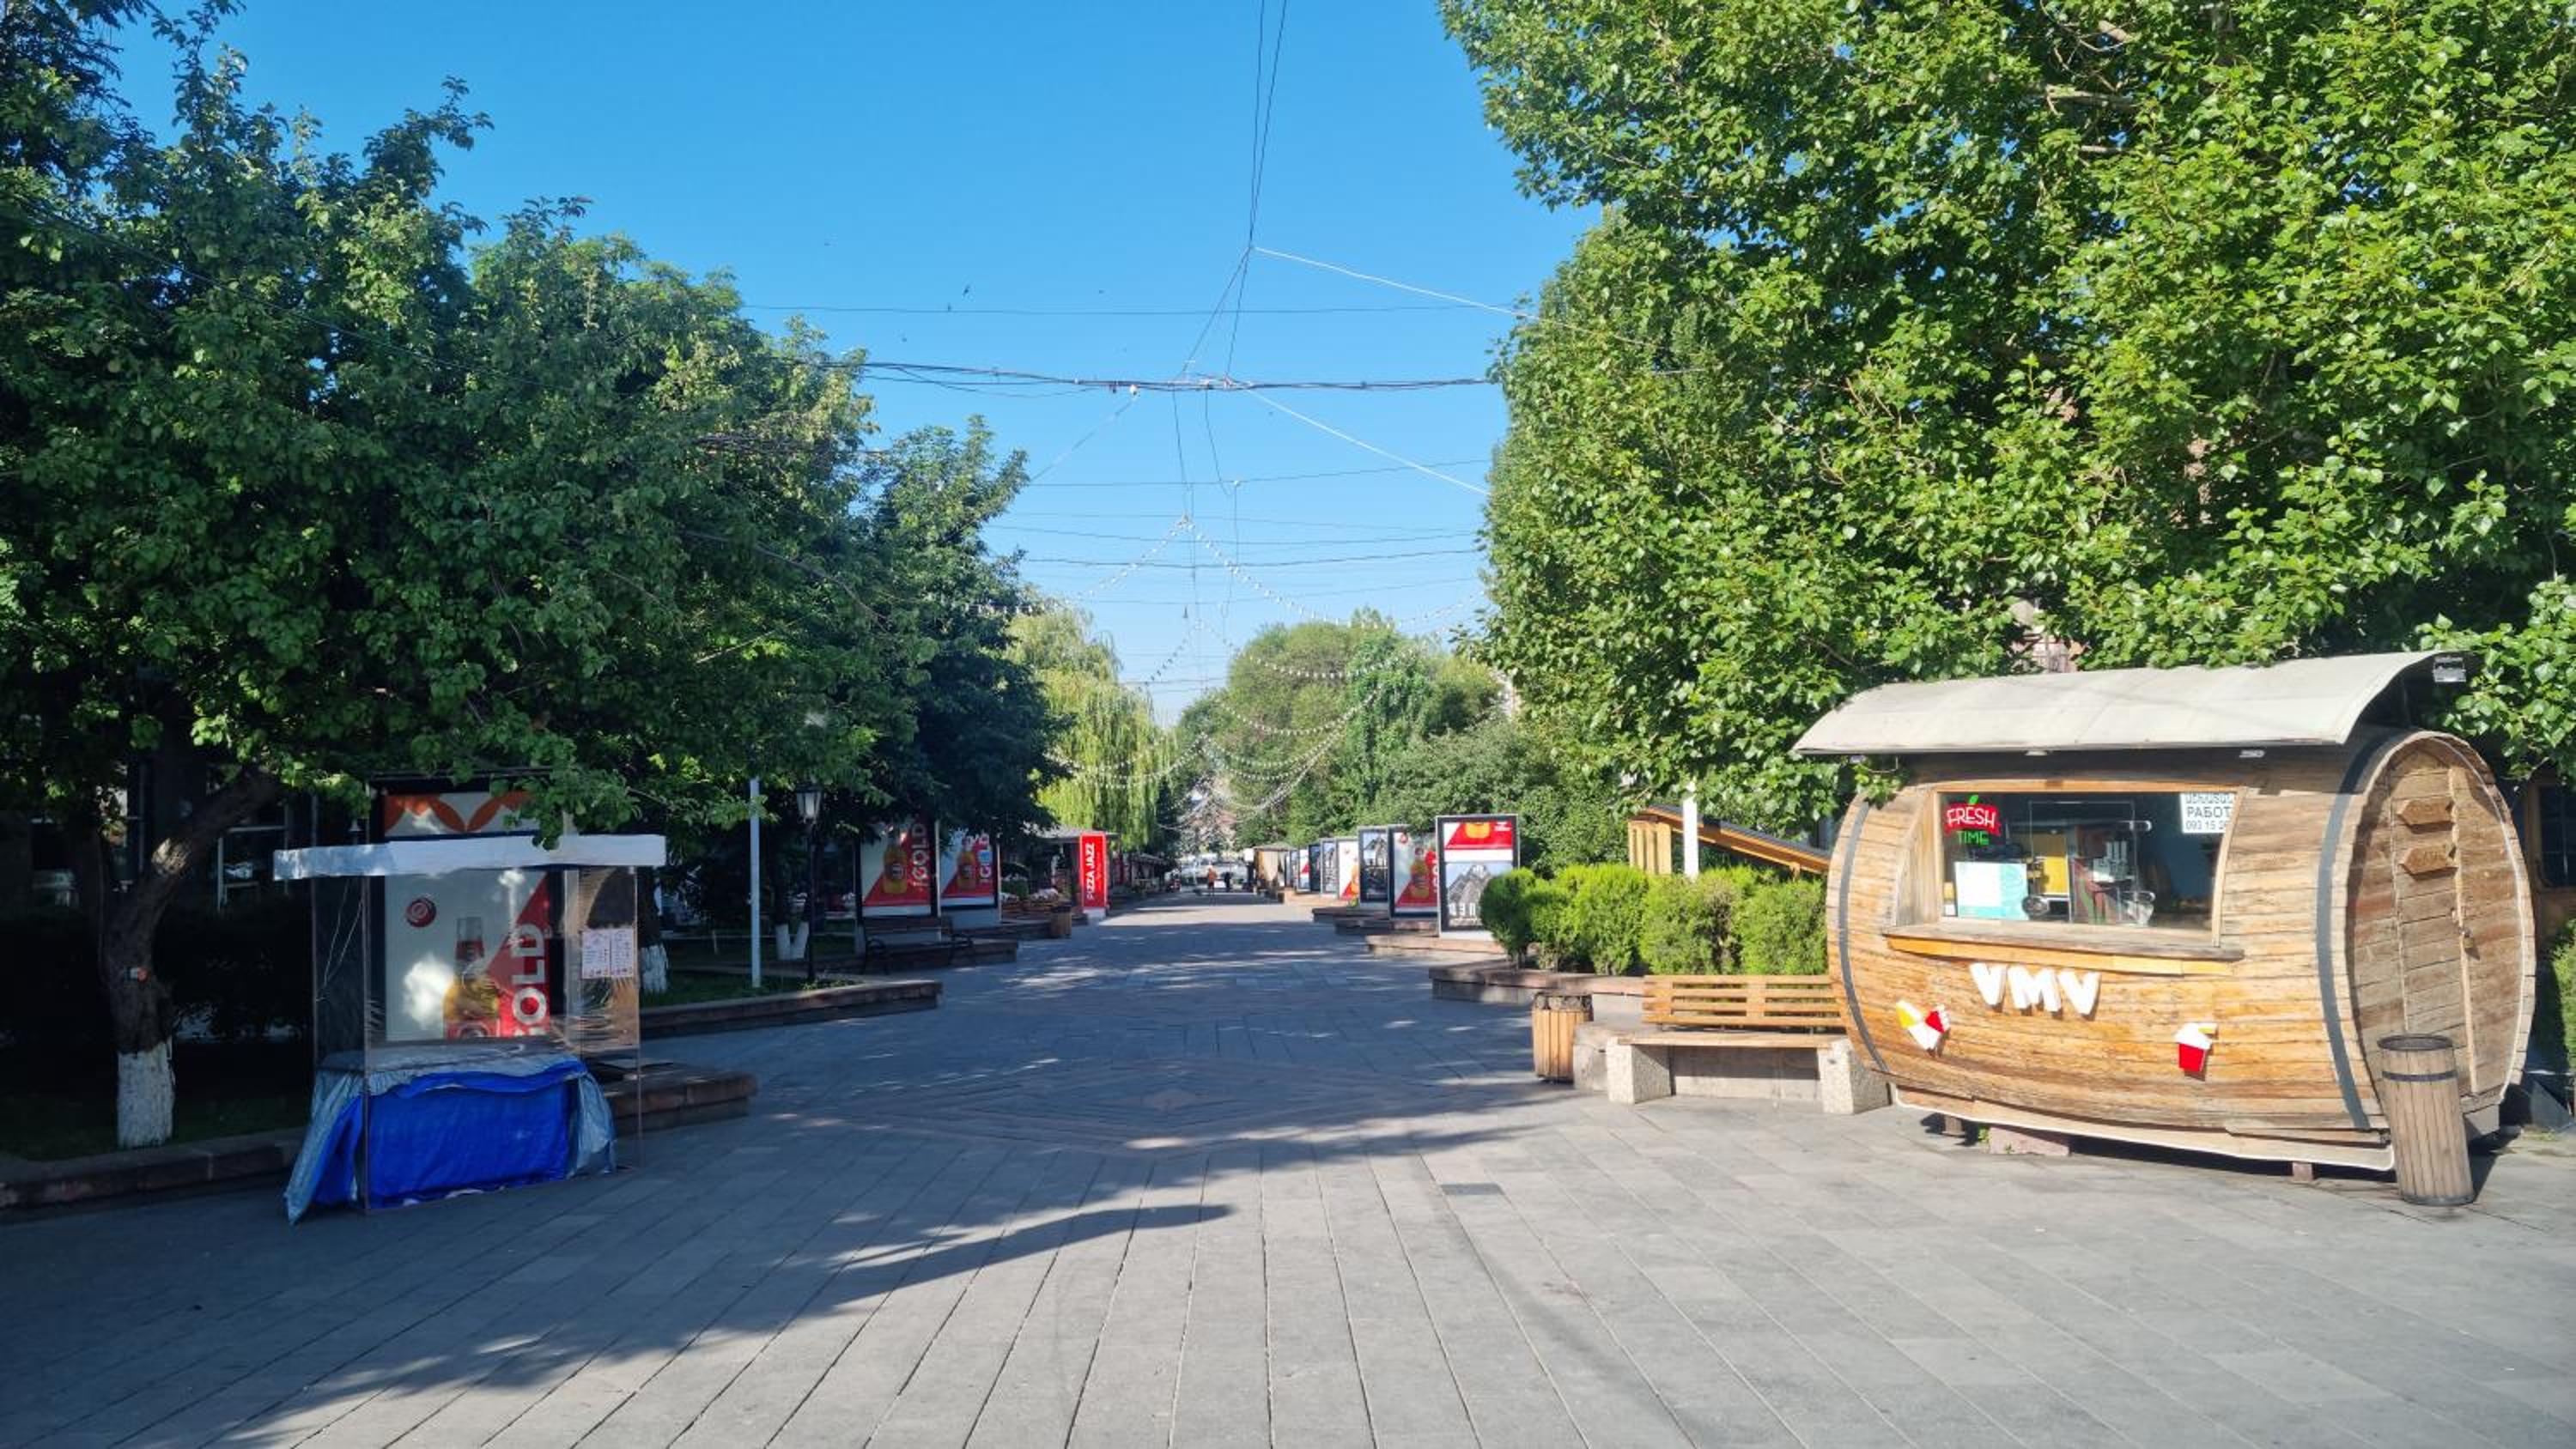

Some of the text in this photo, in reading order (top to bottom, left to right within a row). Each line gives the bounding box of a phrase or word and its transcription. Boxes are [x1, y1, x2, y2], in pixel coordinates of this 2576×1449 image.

[1947, 807, 1996, 829] FRESH
[1957, 830, 1990, 845] TIME
[1084, 842, 1096, 900] PIZZA JAZZ
[512, 923, 547, 1036] OLD
[1969, 961, 2101, 1015] VMV
